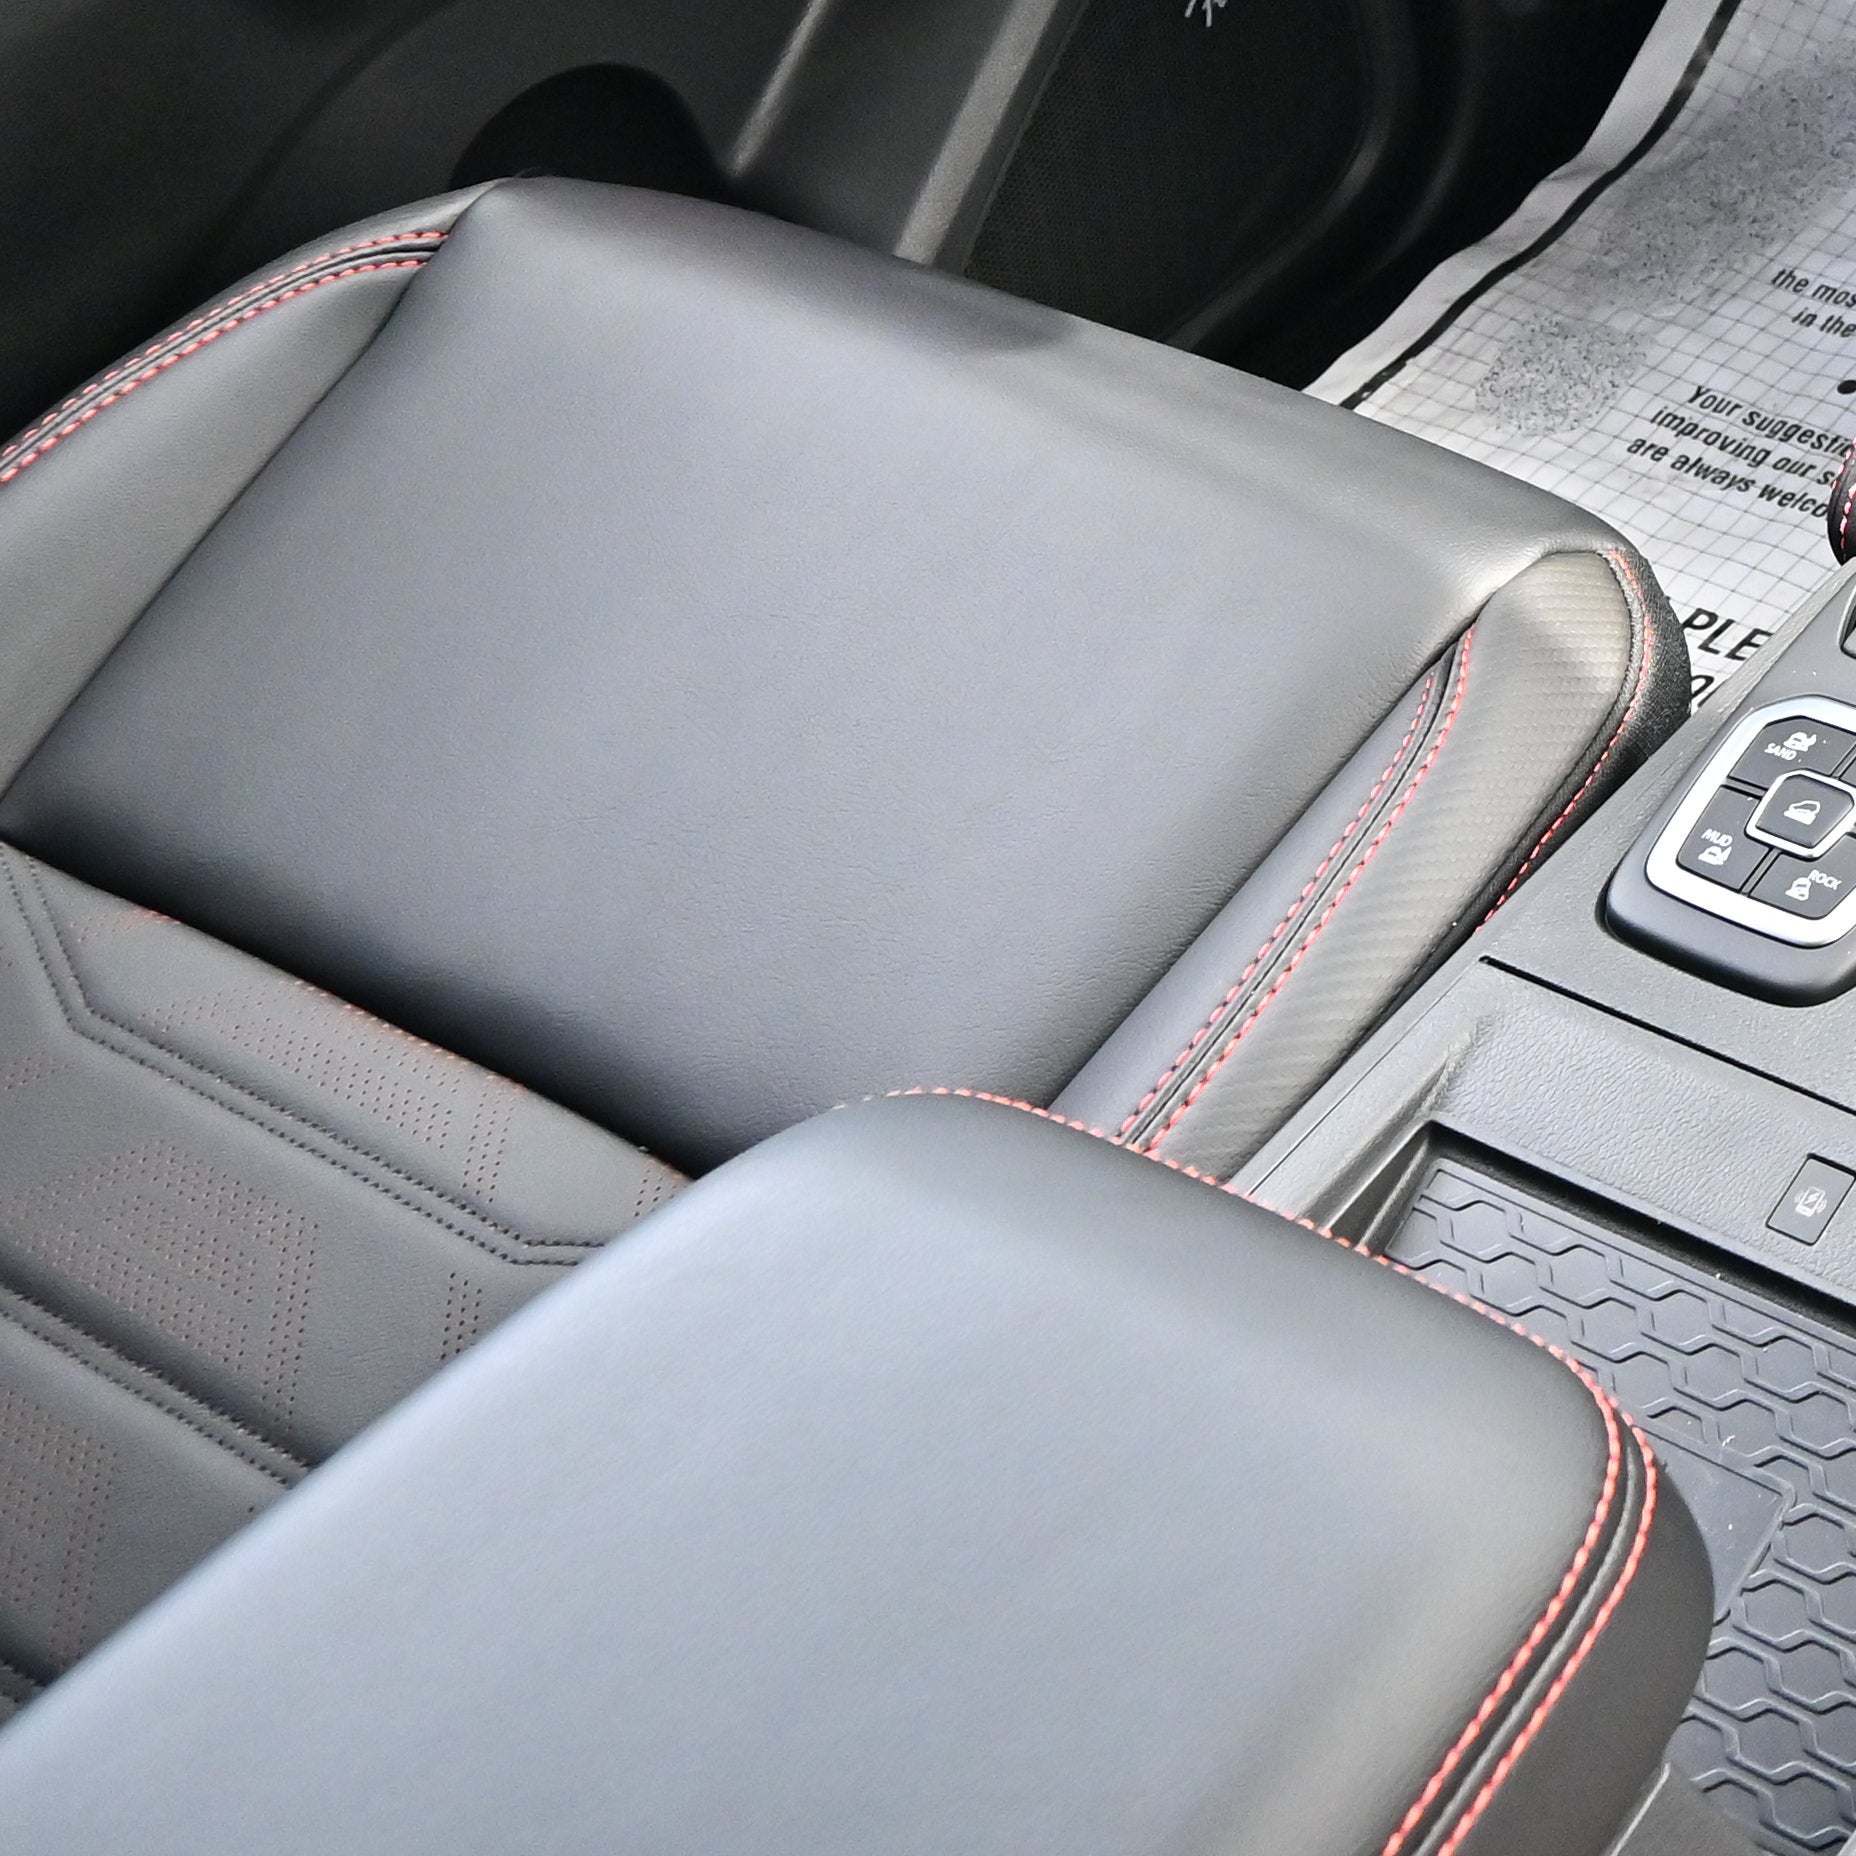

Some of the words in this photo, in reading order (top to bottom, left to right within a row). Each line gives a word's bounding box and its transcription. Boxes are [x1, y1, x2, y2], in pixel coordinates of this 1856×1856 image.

[1771, 268, 1809, 293] the
[1791, 307, 1817, 328] in
[1819, 315, 1856, 338] the
[1687, 385, 1743, 418] Your
[1650, 406, 1773, 469] improving
[1772, 456, 1817, 479] our
[1626, 437, 1670, 463] are
[1670, 453, 1756, 493] always
[1764, 742, 1797, 762] SAND
[1701, 828, 1734, 846] MUD
[1809, 869, 1843, 891] ROCK
